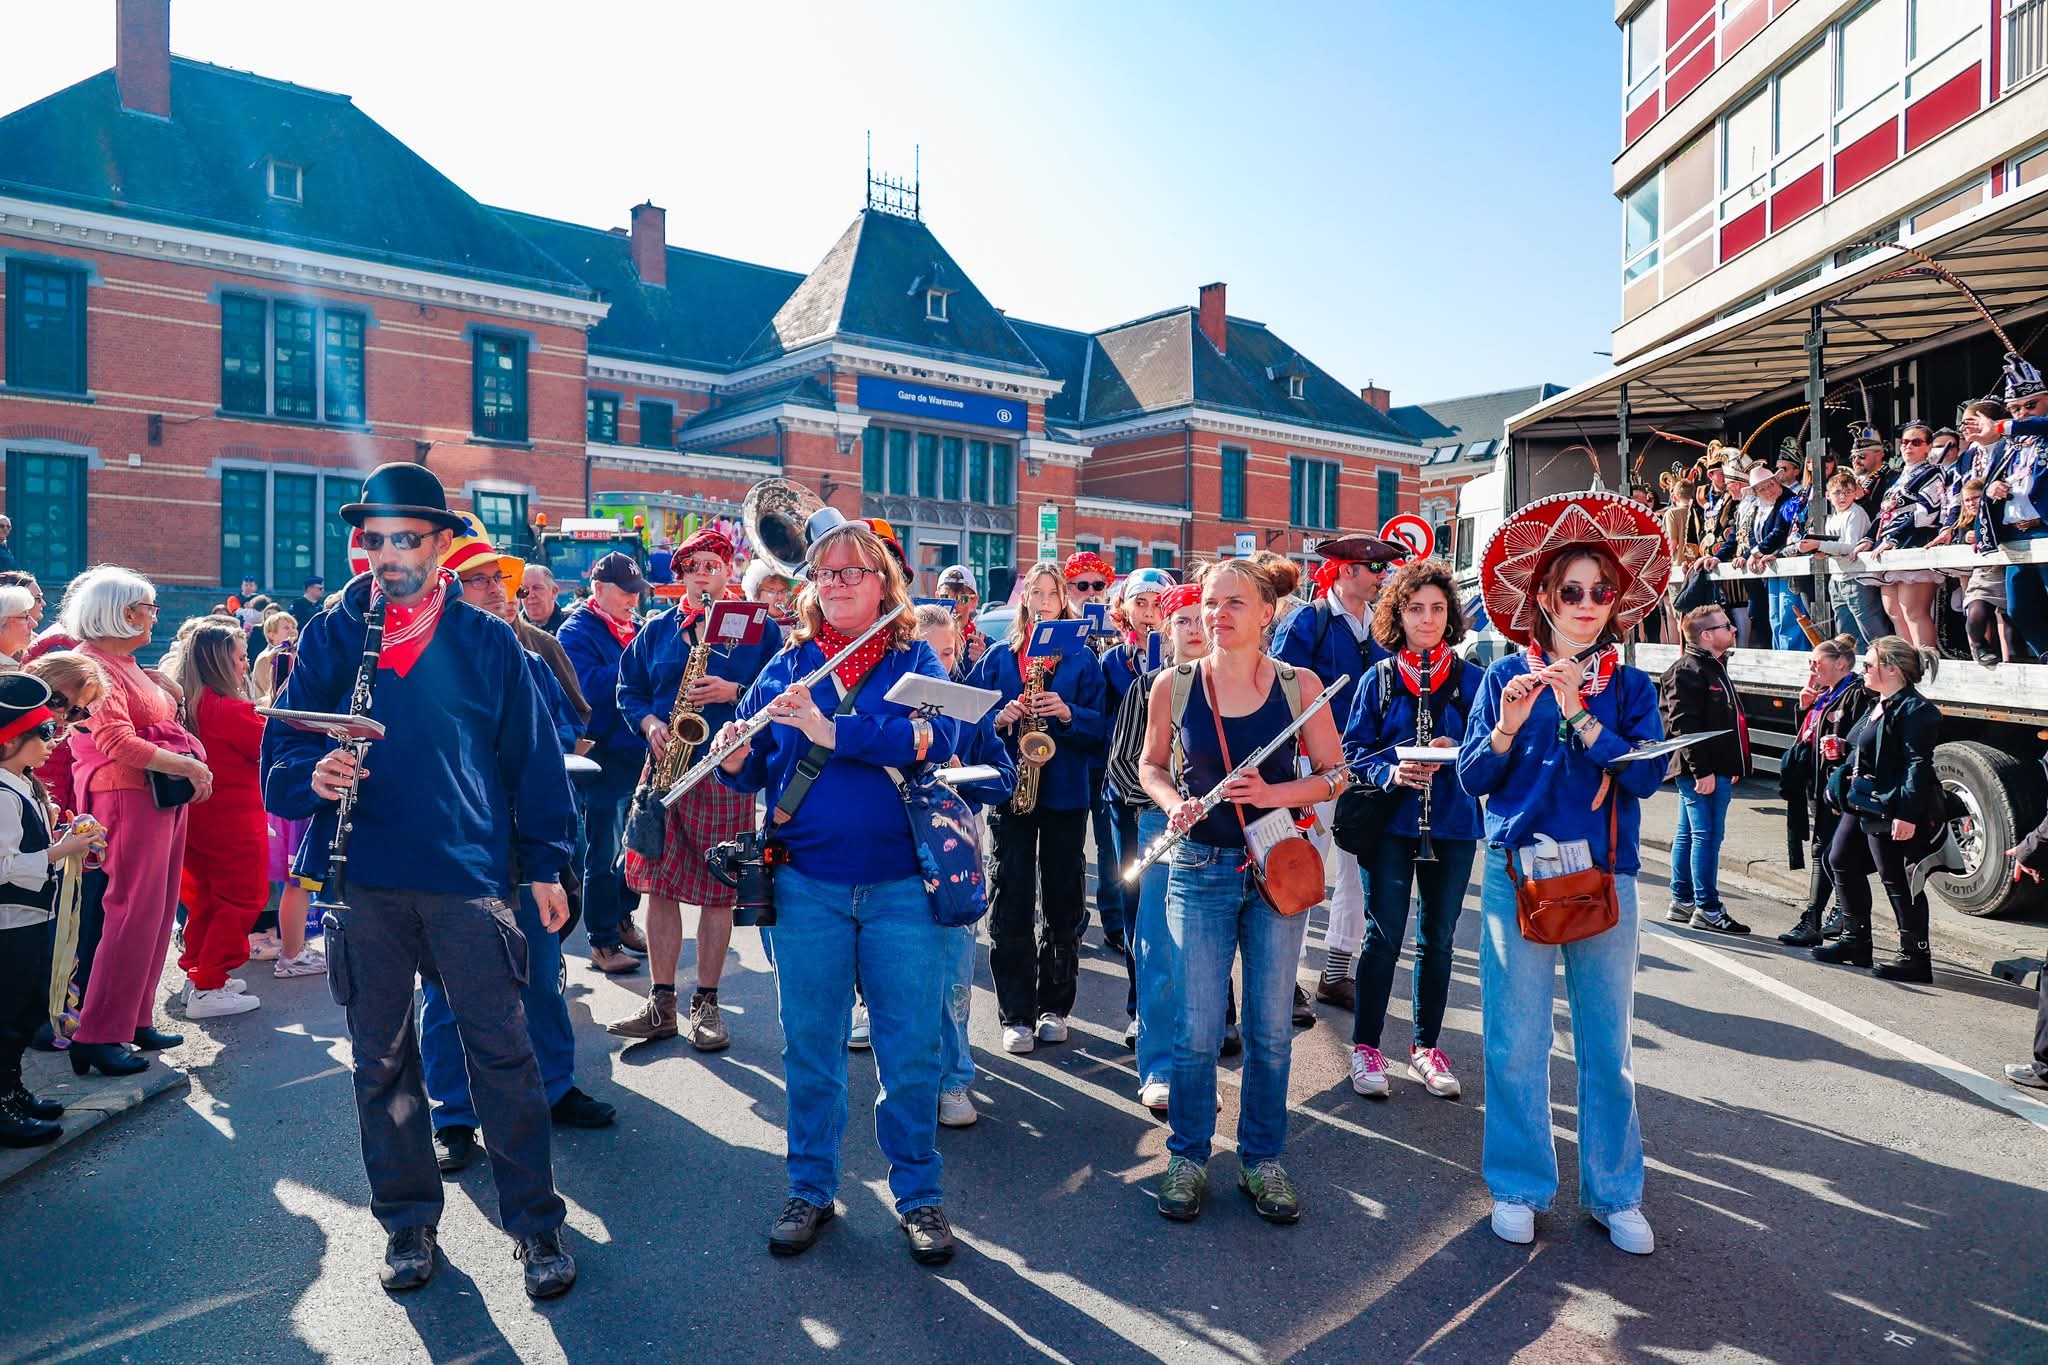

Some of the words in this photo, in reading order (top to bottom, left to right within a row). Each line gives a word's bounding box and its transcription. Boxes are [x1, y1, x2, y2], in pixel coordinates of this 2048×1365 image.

[898, 390, 916, 402] Gare
[917, 393, 927, 403] de
[928, 395, 964, 409] Waremme
[1944, 881, 1978, 895] FULDA
